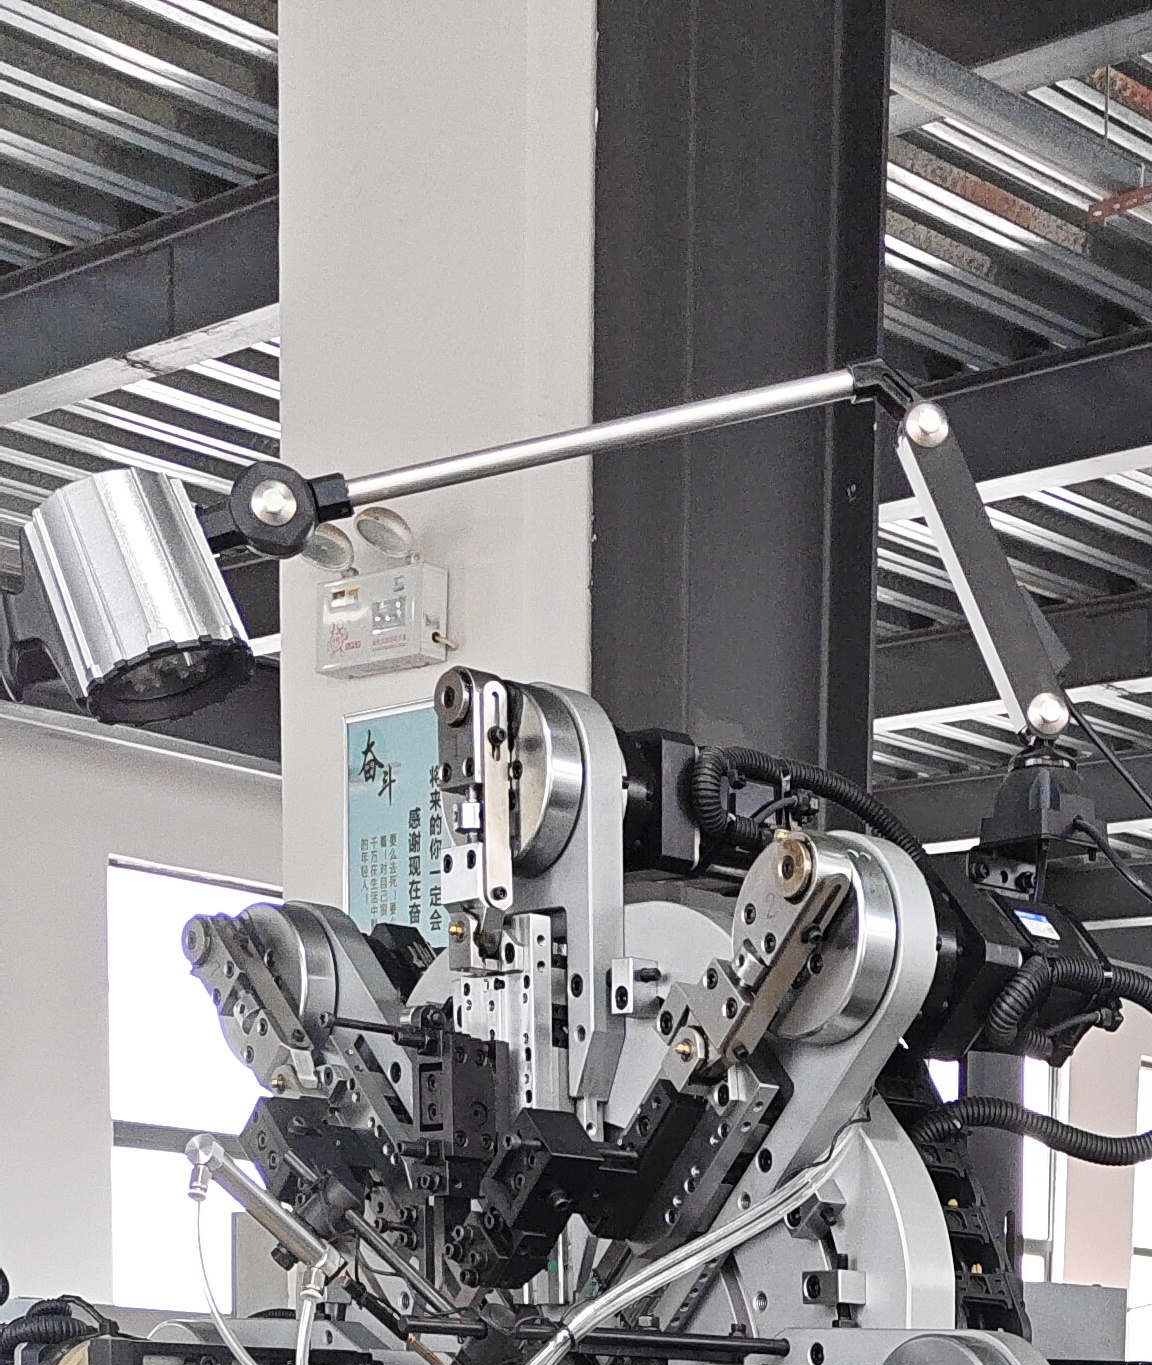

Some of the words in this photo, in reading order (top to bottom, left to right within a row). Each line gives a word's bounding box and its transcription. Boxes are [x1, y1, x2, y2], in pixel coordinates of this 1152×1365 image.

[359, 729, 396, 806] 奋斗
[408, 807, 421, 924] 感谢现在奋
